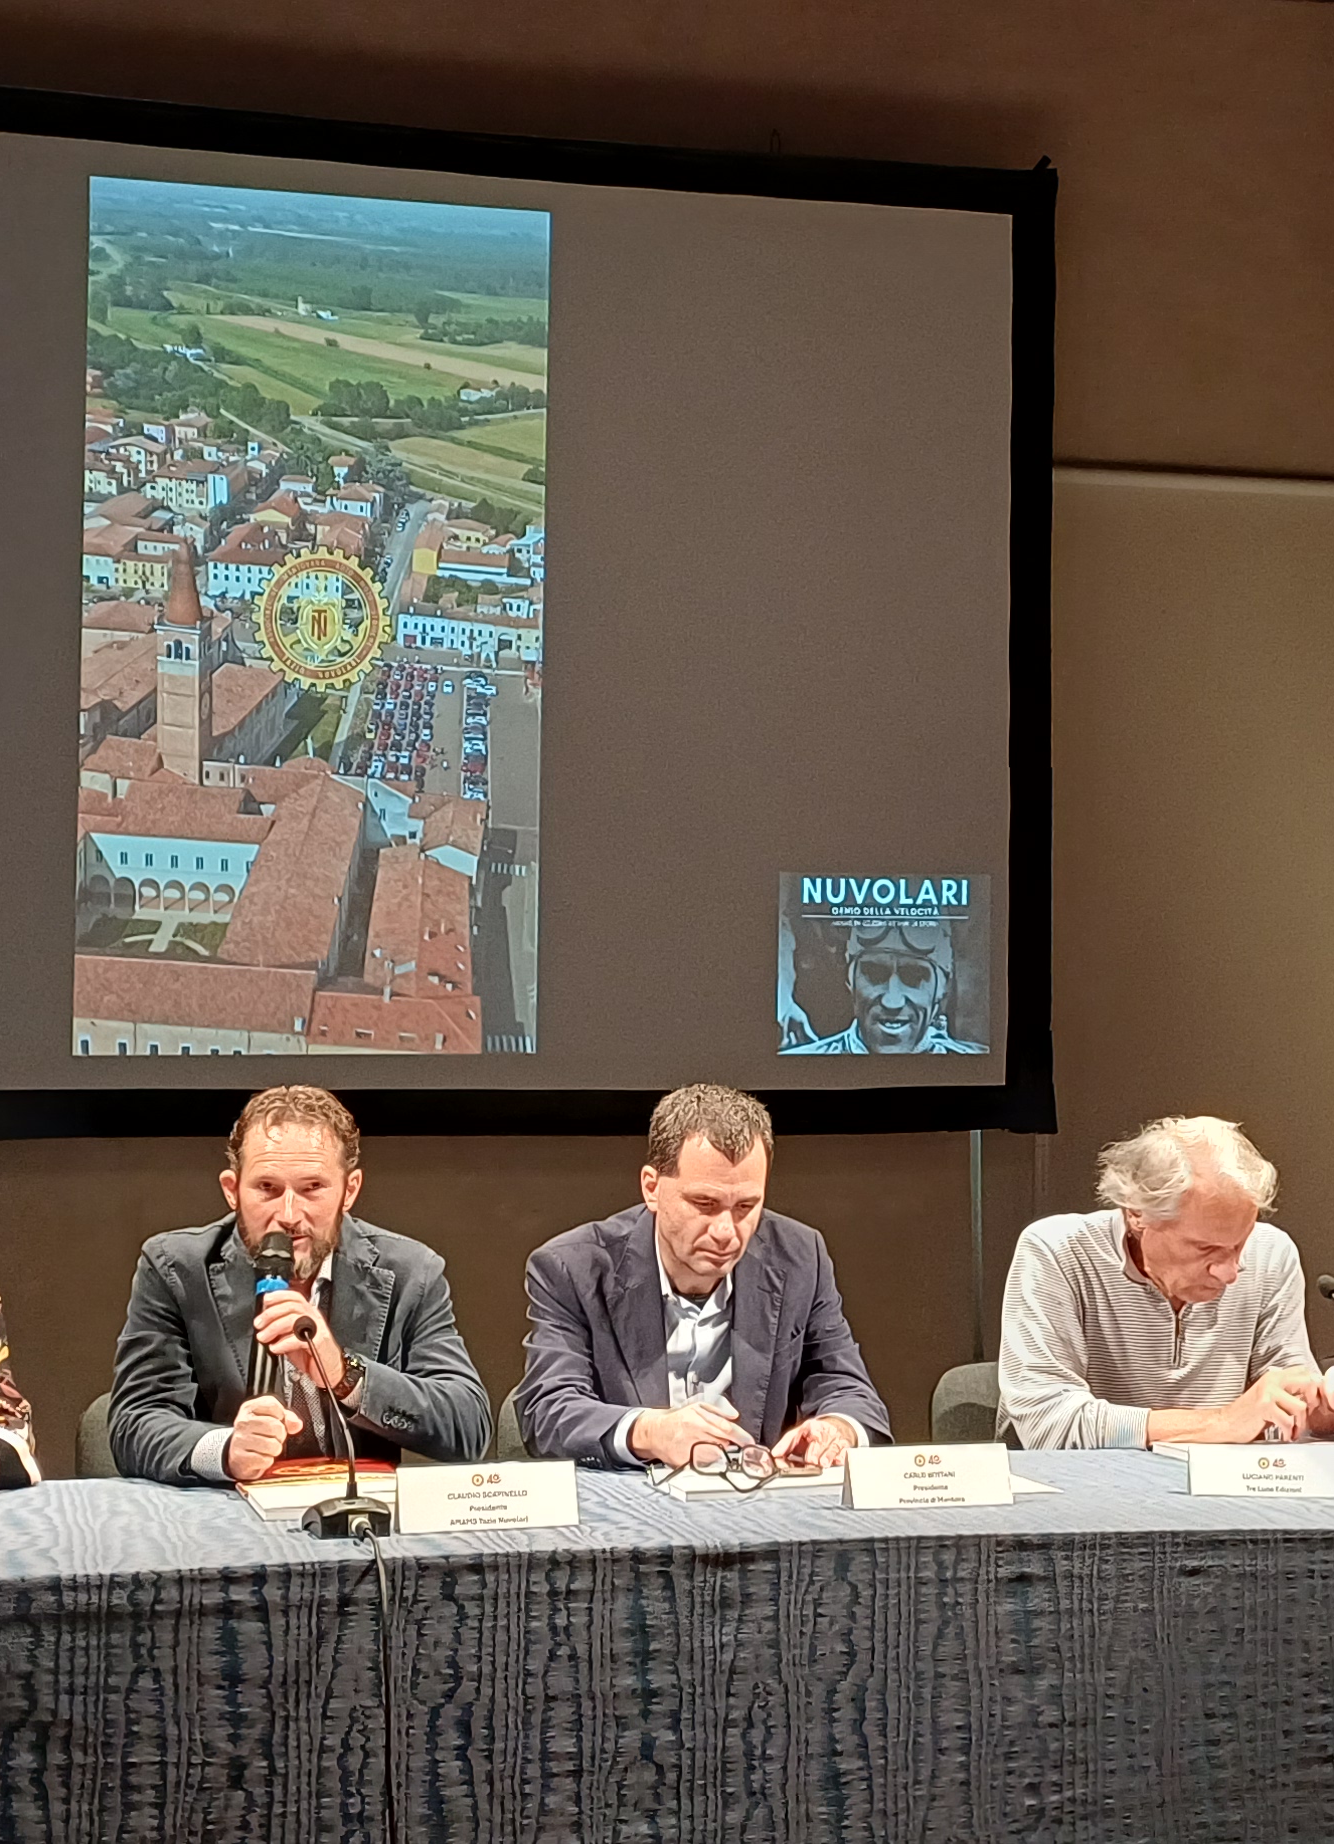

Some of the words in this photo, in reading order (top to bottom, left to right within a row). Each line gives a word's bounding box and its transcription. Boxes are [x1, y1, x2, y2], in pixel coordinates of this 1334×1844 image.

[282, 656, 306, 674] TAZIO
[317, 657, 361, 679] NUVOLARI
[803, 878, 968, 905] NUVOLARI
[831, 907, 861, 915] GENIO
[863, 907, 891, 915] DELLA
[894, 906, 939, 916] VELOCITÀ
[913, 1484, 948, 1492] Presidente
[447, 1492, 480, 1500] CLAUDIO
[482, 1490, 527, 1498] SCAPINELLO
[469, 1504, 507, 1512] Presidente
[479, 1517, 496, 1525] Tazio
[498, 1515, 528, 1524] Nuvolari
